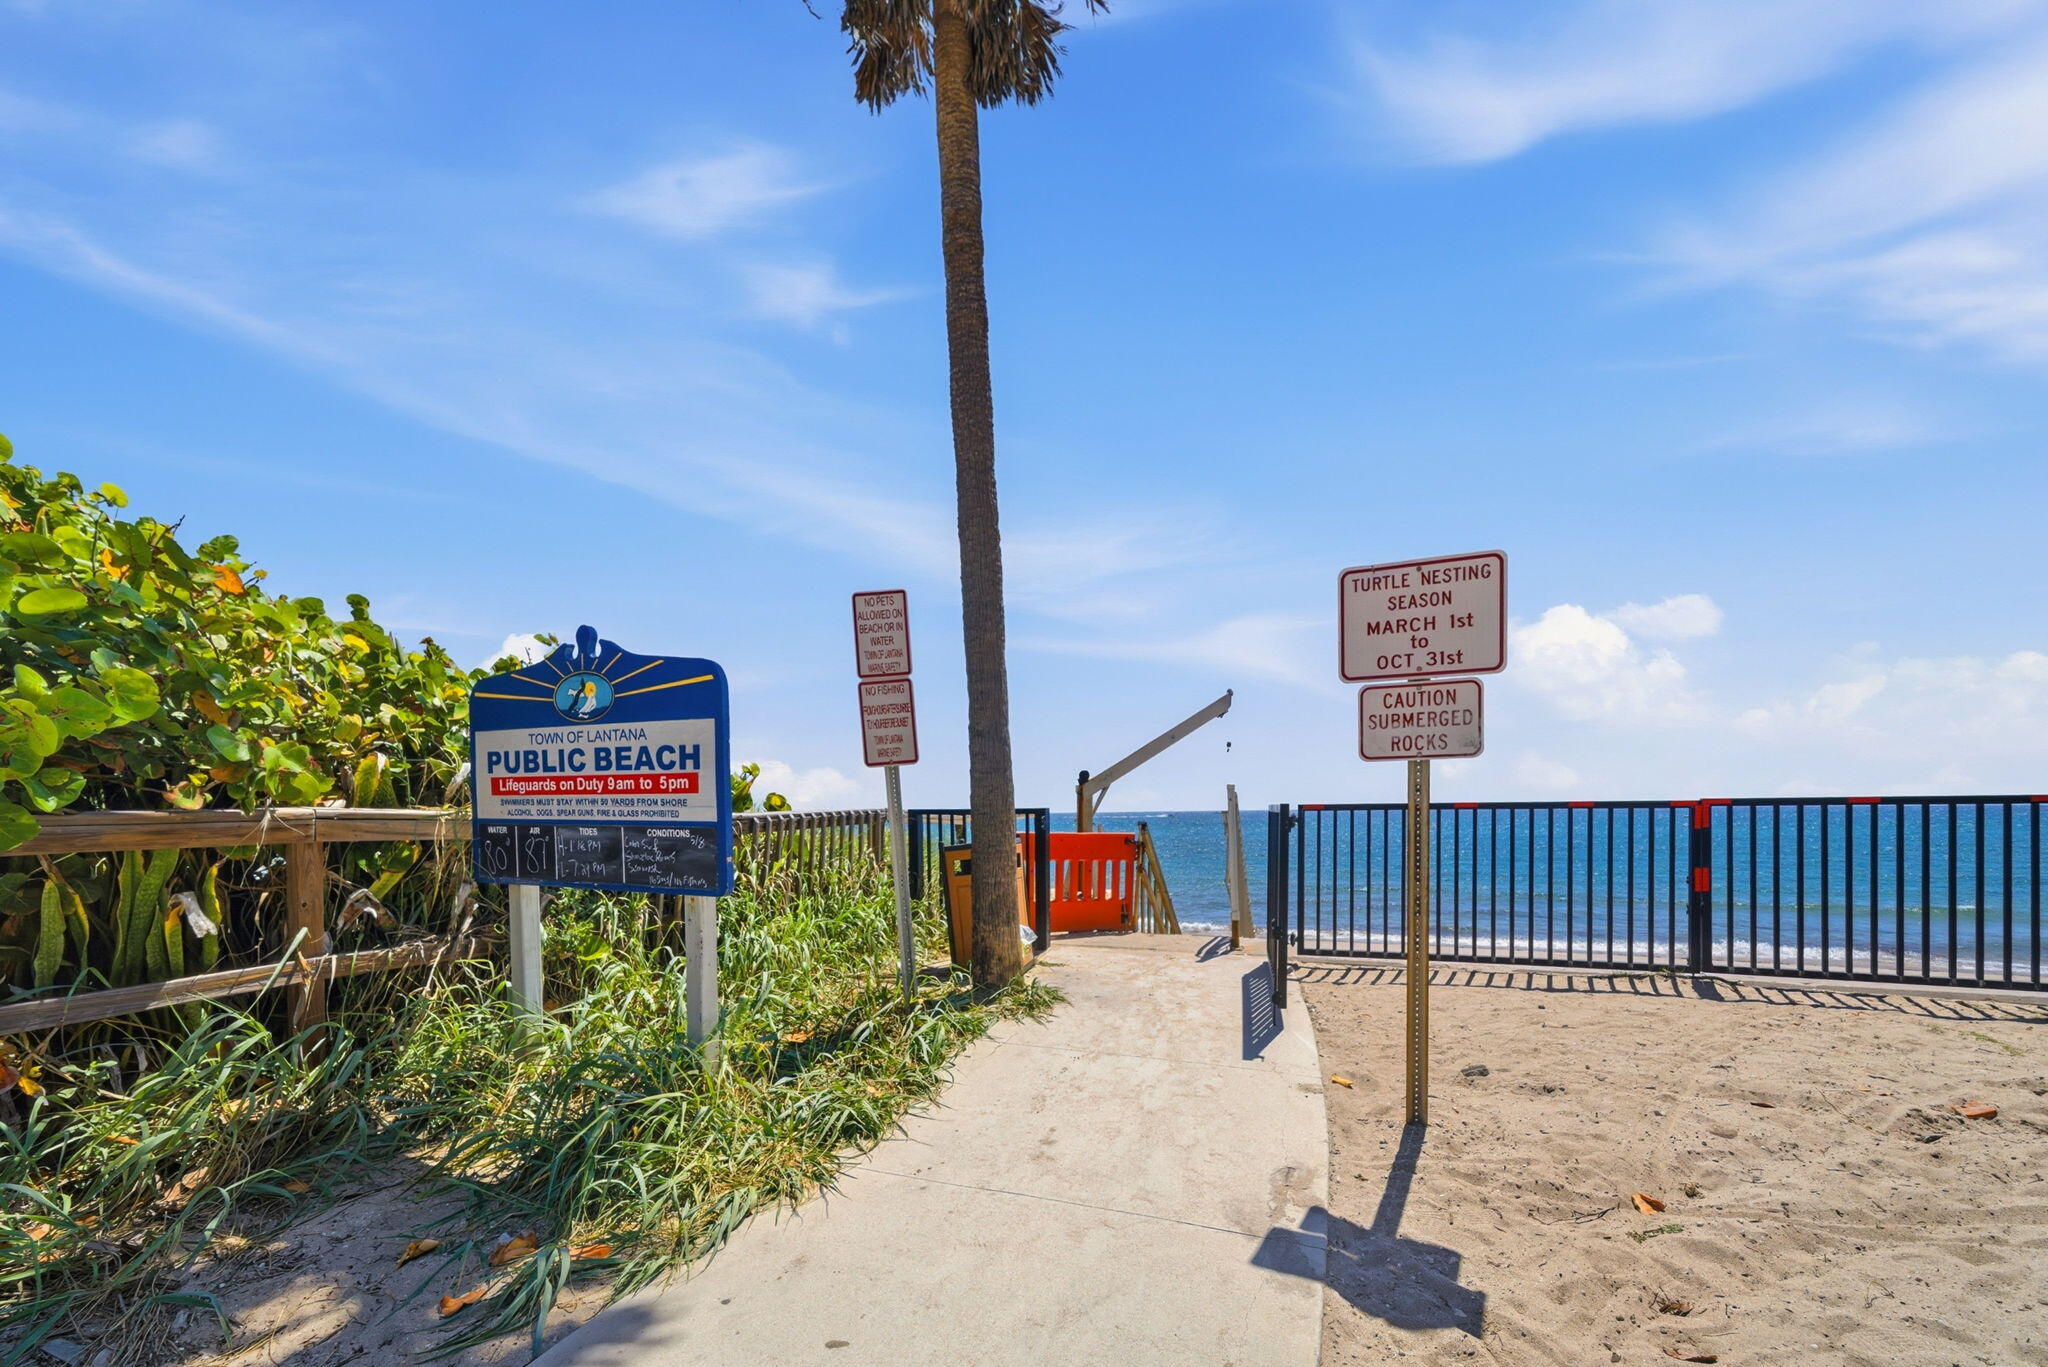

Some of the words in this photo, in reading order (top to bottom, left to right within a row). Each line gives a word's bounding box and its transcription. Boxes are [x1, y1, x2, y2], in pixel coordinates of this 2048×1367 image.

[1352, 573, 1410, 592] TURTLE
[1421, 564, 1491, 586] NESTING
[864, 597, 875, 607] NO
[876, 596, 894, 606] PETS
[1388, 590, 1452, 611] SEASON
[858, 609, 891, 620] ALLOWED
[892, 608, 903, 619] ON
[859, 623, 883, 634] BEACH
[884, 622, 895, 632] OR
[896, 622, 903, 631] IN
[1367, 616, 1436, 636] MARCH
[1450, 612, 1474, 628] 1st
[870, 636, 894, 646] WATER
[1410, 636, 1429, 649] to
[1377, 653, 1414, 670] OCT
[1426, 650, 1464, 666] 31st
[865, 686, 876, 696] NO
[878, 684, 904, 695] FISHING
[1383, 689, 1456, 709] CAUTION
[1368, 709, 1473, 730] SUBMERGED
[528, 732, 564, 745] TOWN
[567, 730, 584, 744] OF
[587, 728, 647, 743] LANTANA
[1391, 734, 1448, 752] ROCKS
[487, 748, 586, 774] PUBLIC
[594, 744, 700, 771] BEACH
[499, 778, 556, 793] Lifeguards
[560, 780, 574, 790] on
[577, 777, 604, 794] Duty
[639, 778, 653, 789] to
[537, 798, 554, 806] MUST
[556, 798, 573, 806] STAY
[576, 798, 598, 806] WITHIN
[601, 798, 608, 806] 50
[610, 798, 635, 806] YARDS
[637, 798, 658, 806] FROM
[660, 798, 688, 806] SHORE
[597, 809, 610, 817] FIRE
[641, 810, 680, 818] PROHIBITED
[488, 826, 507, 834] WATER
[580, 828, 598, 836] TIDES
[647, 829, 690, 838] CONDITIONS
